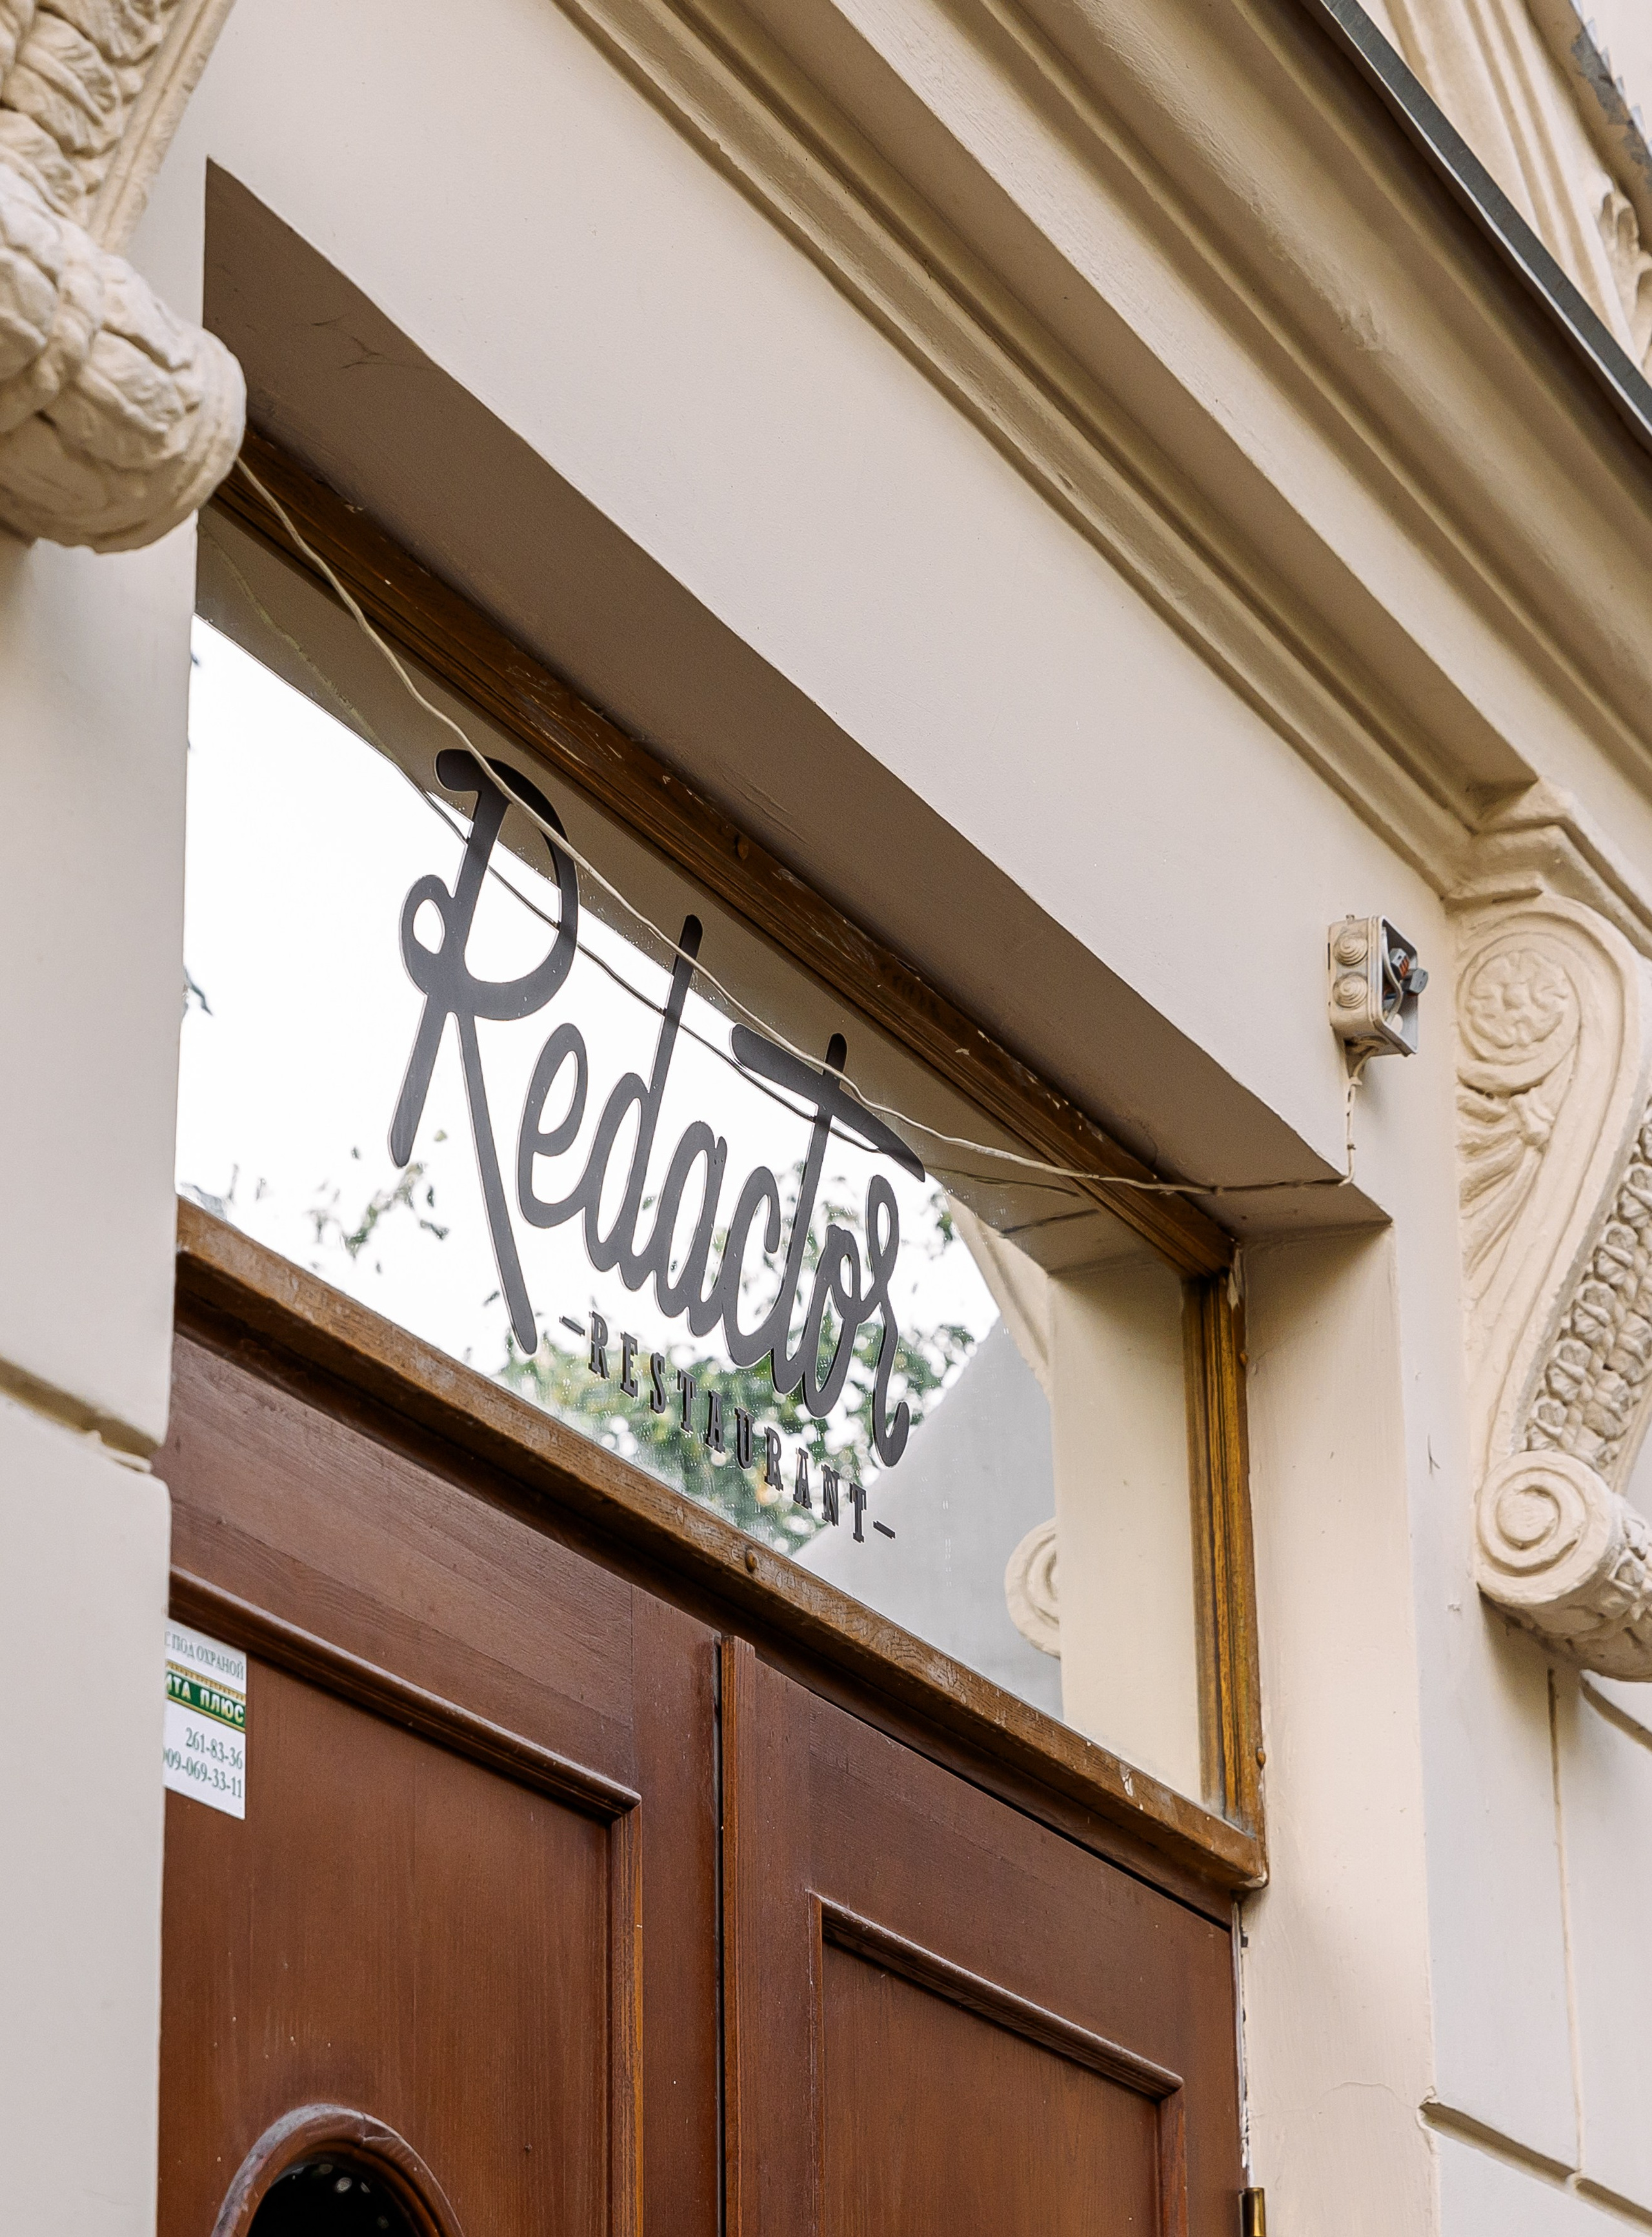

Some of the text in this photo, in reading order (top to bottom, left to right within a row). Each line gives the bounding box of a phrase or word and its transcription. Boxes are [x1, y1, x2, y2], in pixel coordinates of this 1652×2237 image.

[390, 749, 925, 1467] Redactor
[172, 1634, 195, 1659] ПОД
[196, 1645, 244, 1680] ОХРАНОЙ
[199, 1688, 244, 1723] ПЛЮС
[186, 1726, 243, 1770] 261-83-36
